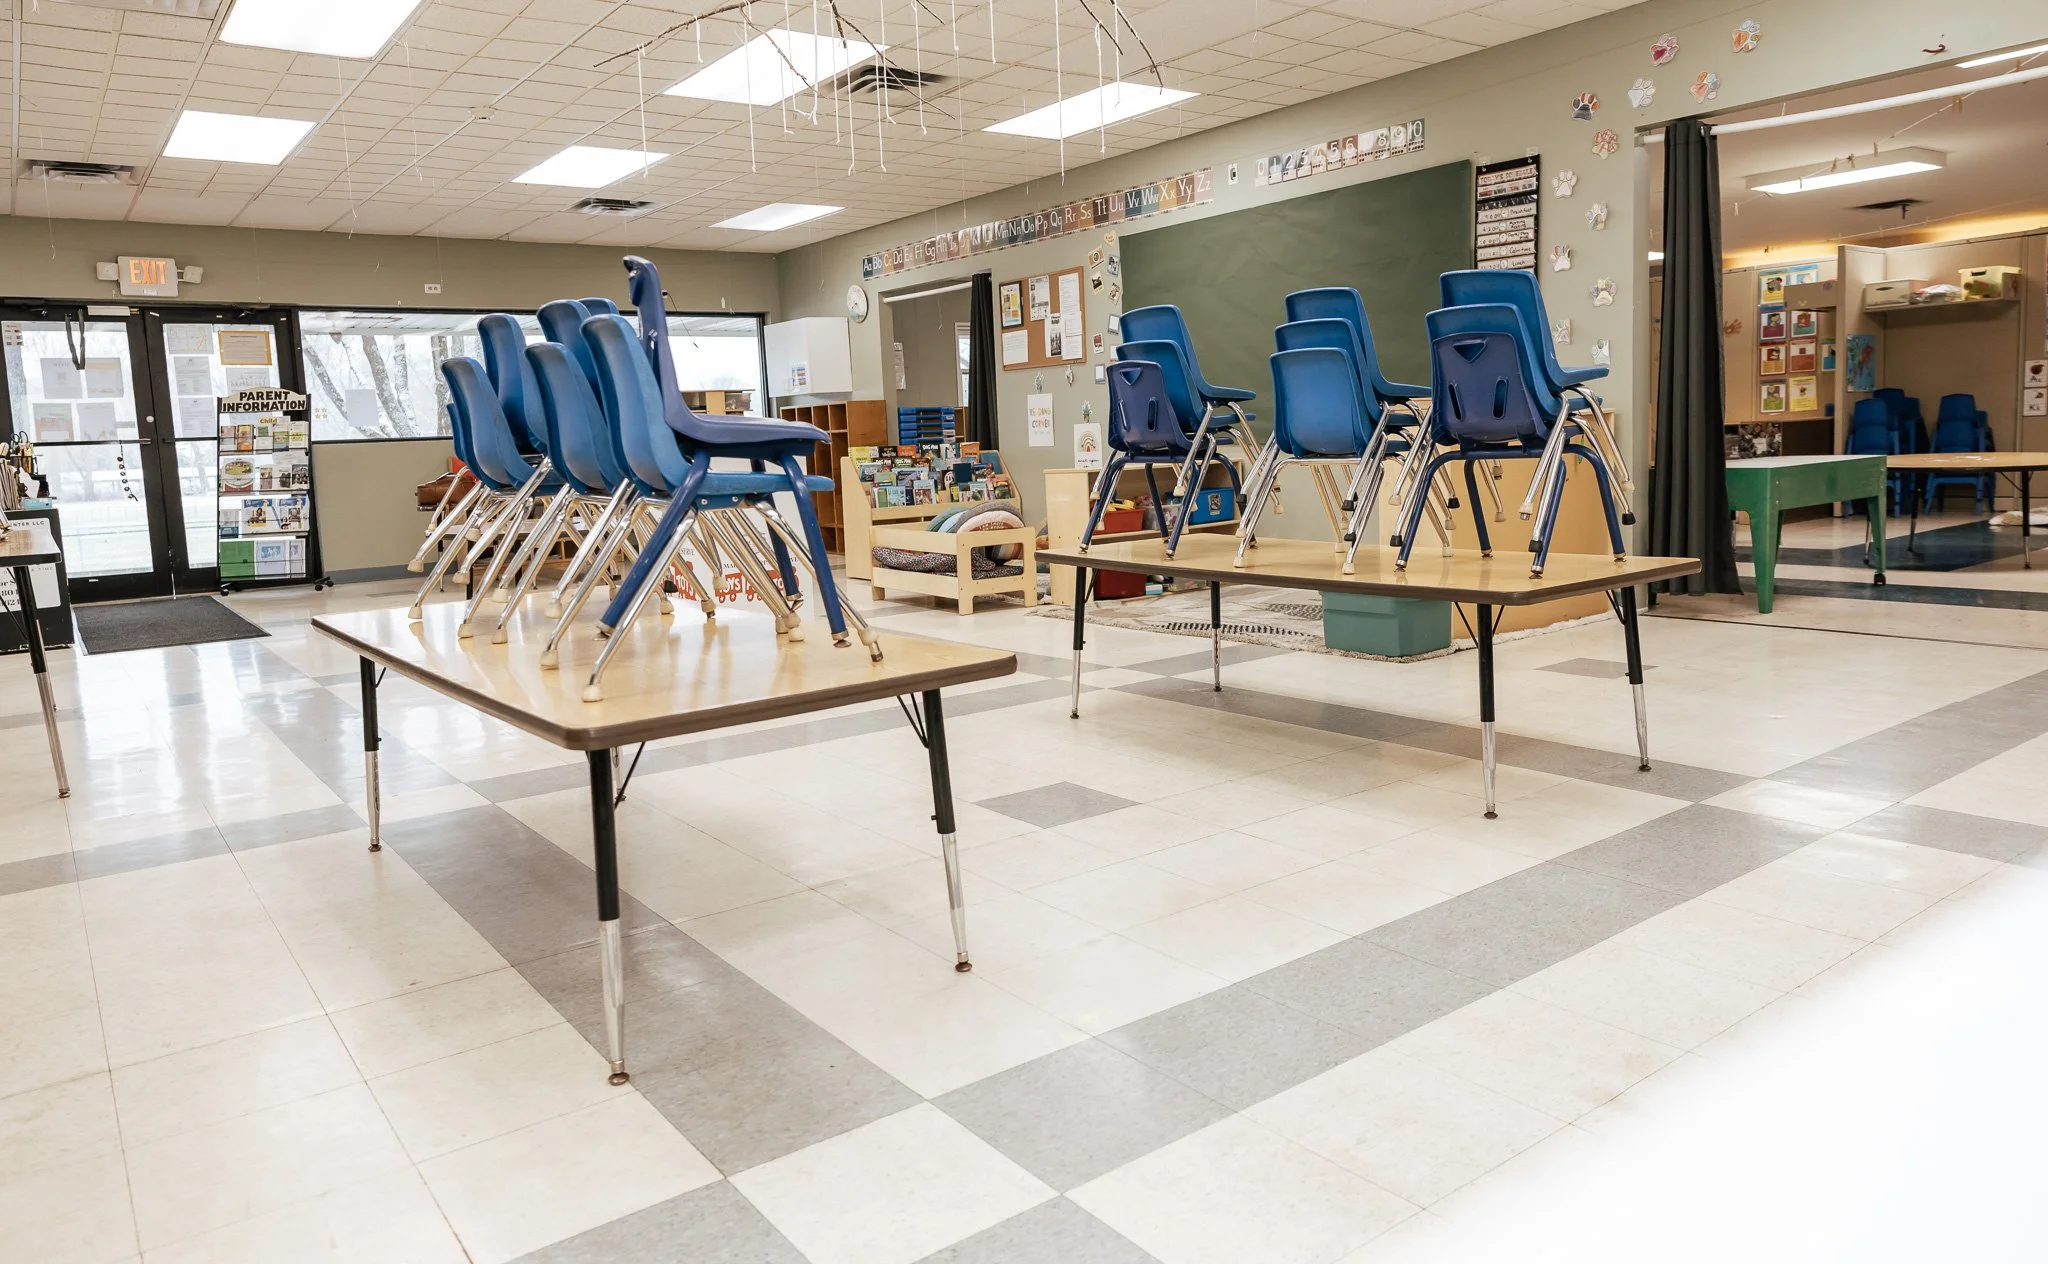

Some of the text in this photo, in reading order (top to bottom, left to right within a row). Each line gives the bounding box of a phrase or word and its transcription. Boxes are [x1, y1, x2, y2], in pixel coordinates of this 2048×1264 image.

[1286, 154, 1293, 170] 2
[1300, 148, 1308, 166] 3
[1330, 142, 1338, 158] 5
[1346, 138, 1354, 154] 6
[1378, 130, 1387, 146] 8
[1395, 126, 1403, 142] 9
[1408, 120, 1422, 139] 10
[864, 259, 872, 272] Aa
[873, 256, 882, 270] Bb
[894, 251, 902, 264] Dd
[914, 244, 922, 259] Ff
[925, 242, 936, 260] Gg
[1009, 221, 1021, 236] Nn
[1022, 218, 1034, 234] Oo
[1036, 216, 1048, 236] Pp
[1050, 211, 1062, 231] Qq
[1065, 208, 1076, 223] Rr
[1080, 204, 1092, 219] Ss
[1095, 199, 1106, 216] Tt
[1110, 196, 1124, 212] Uu
[1126, 192, 1139, 208] Vv
[1141, 188, 1159, 206] Ww
[1160, 183, 1176, 202] Xx
[1178, 178, 1192, 202] Yy
[1197, 174, 1211, 193] Zz
[129, 260, 166, 285] EXIT
[222, 400, 306, 412] INFORMATION
[240, 390, 290, 402] PARENT
